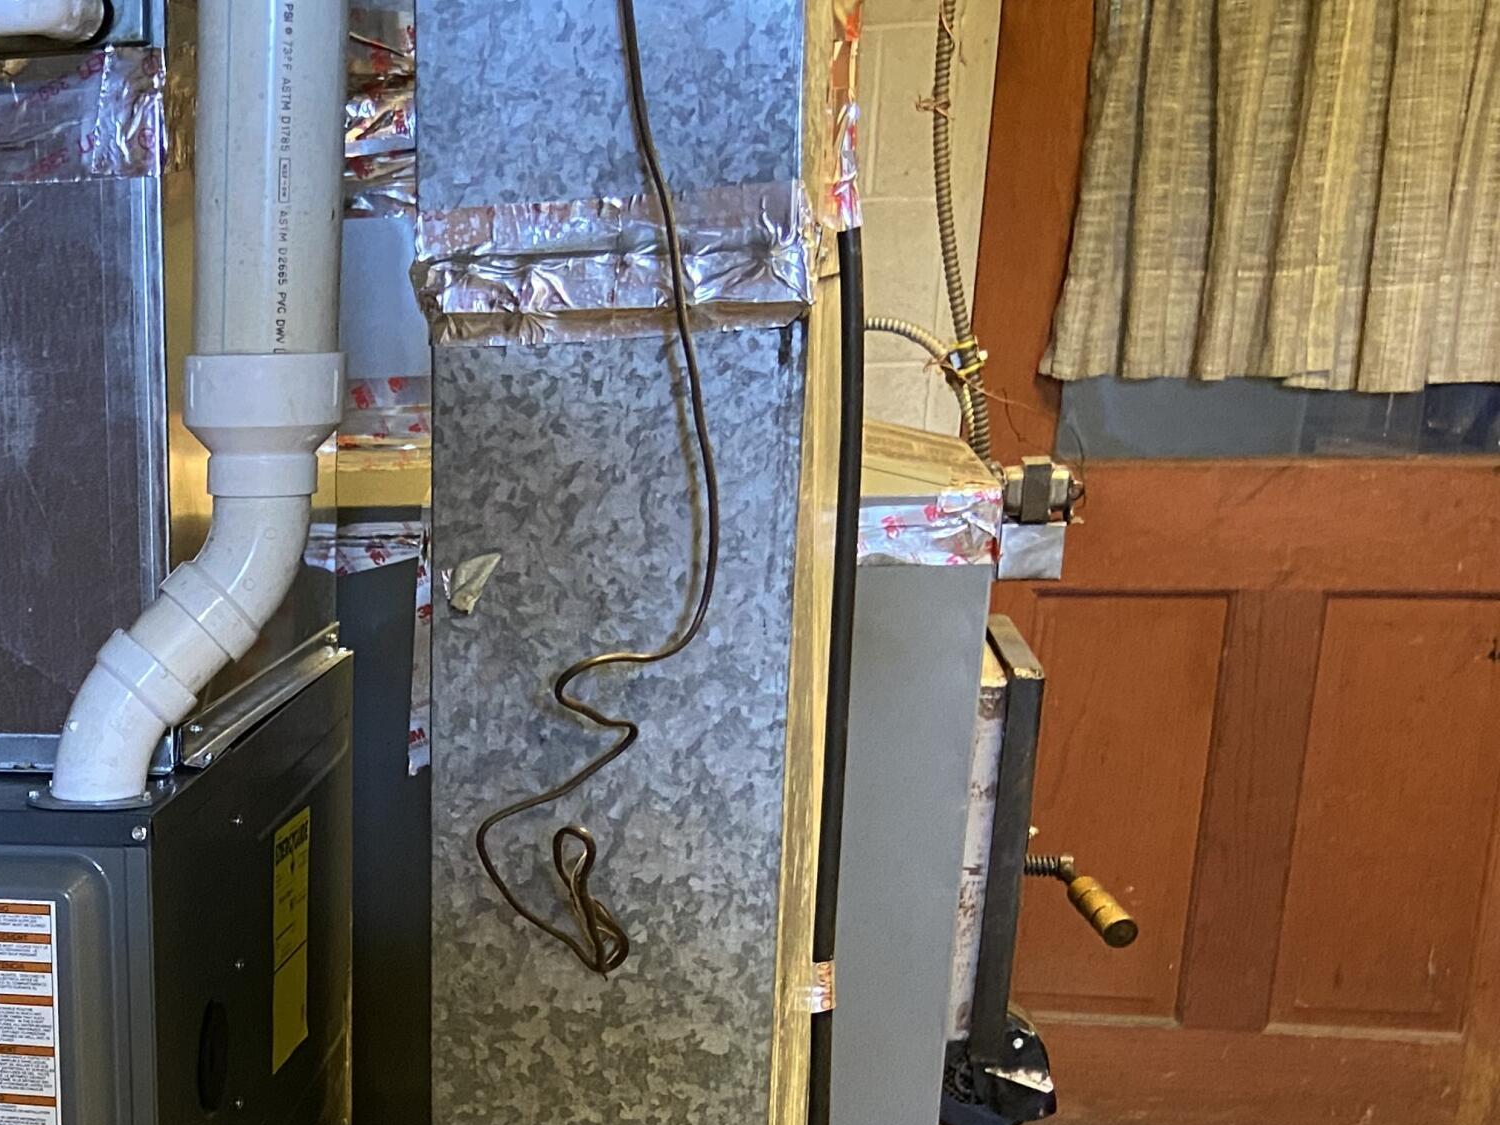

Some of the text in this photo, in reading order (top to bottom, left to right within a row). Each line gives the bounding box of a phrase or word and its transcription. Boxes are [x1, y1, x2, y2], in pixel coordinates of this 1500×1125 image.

[283, 3, 294, 22] PSI
[281, 77, 291, 110] ASTM
[280, 116, 291, 151] D1785
[278, 210, 289, 242] ASTM
[278, 248, 288, 286] D2665
[277, 292, 287, 314] PVC
[275, 319, 286, 343] DWV
